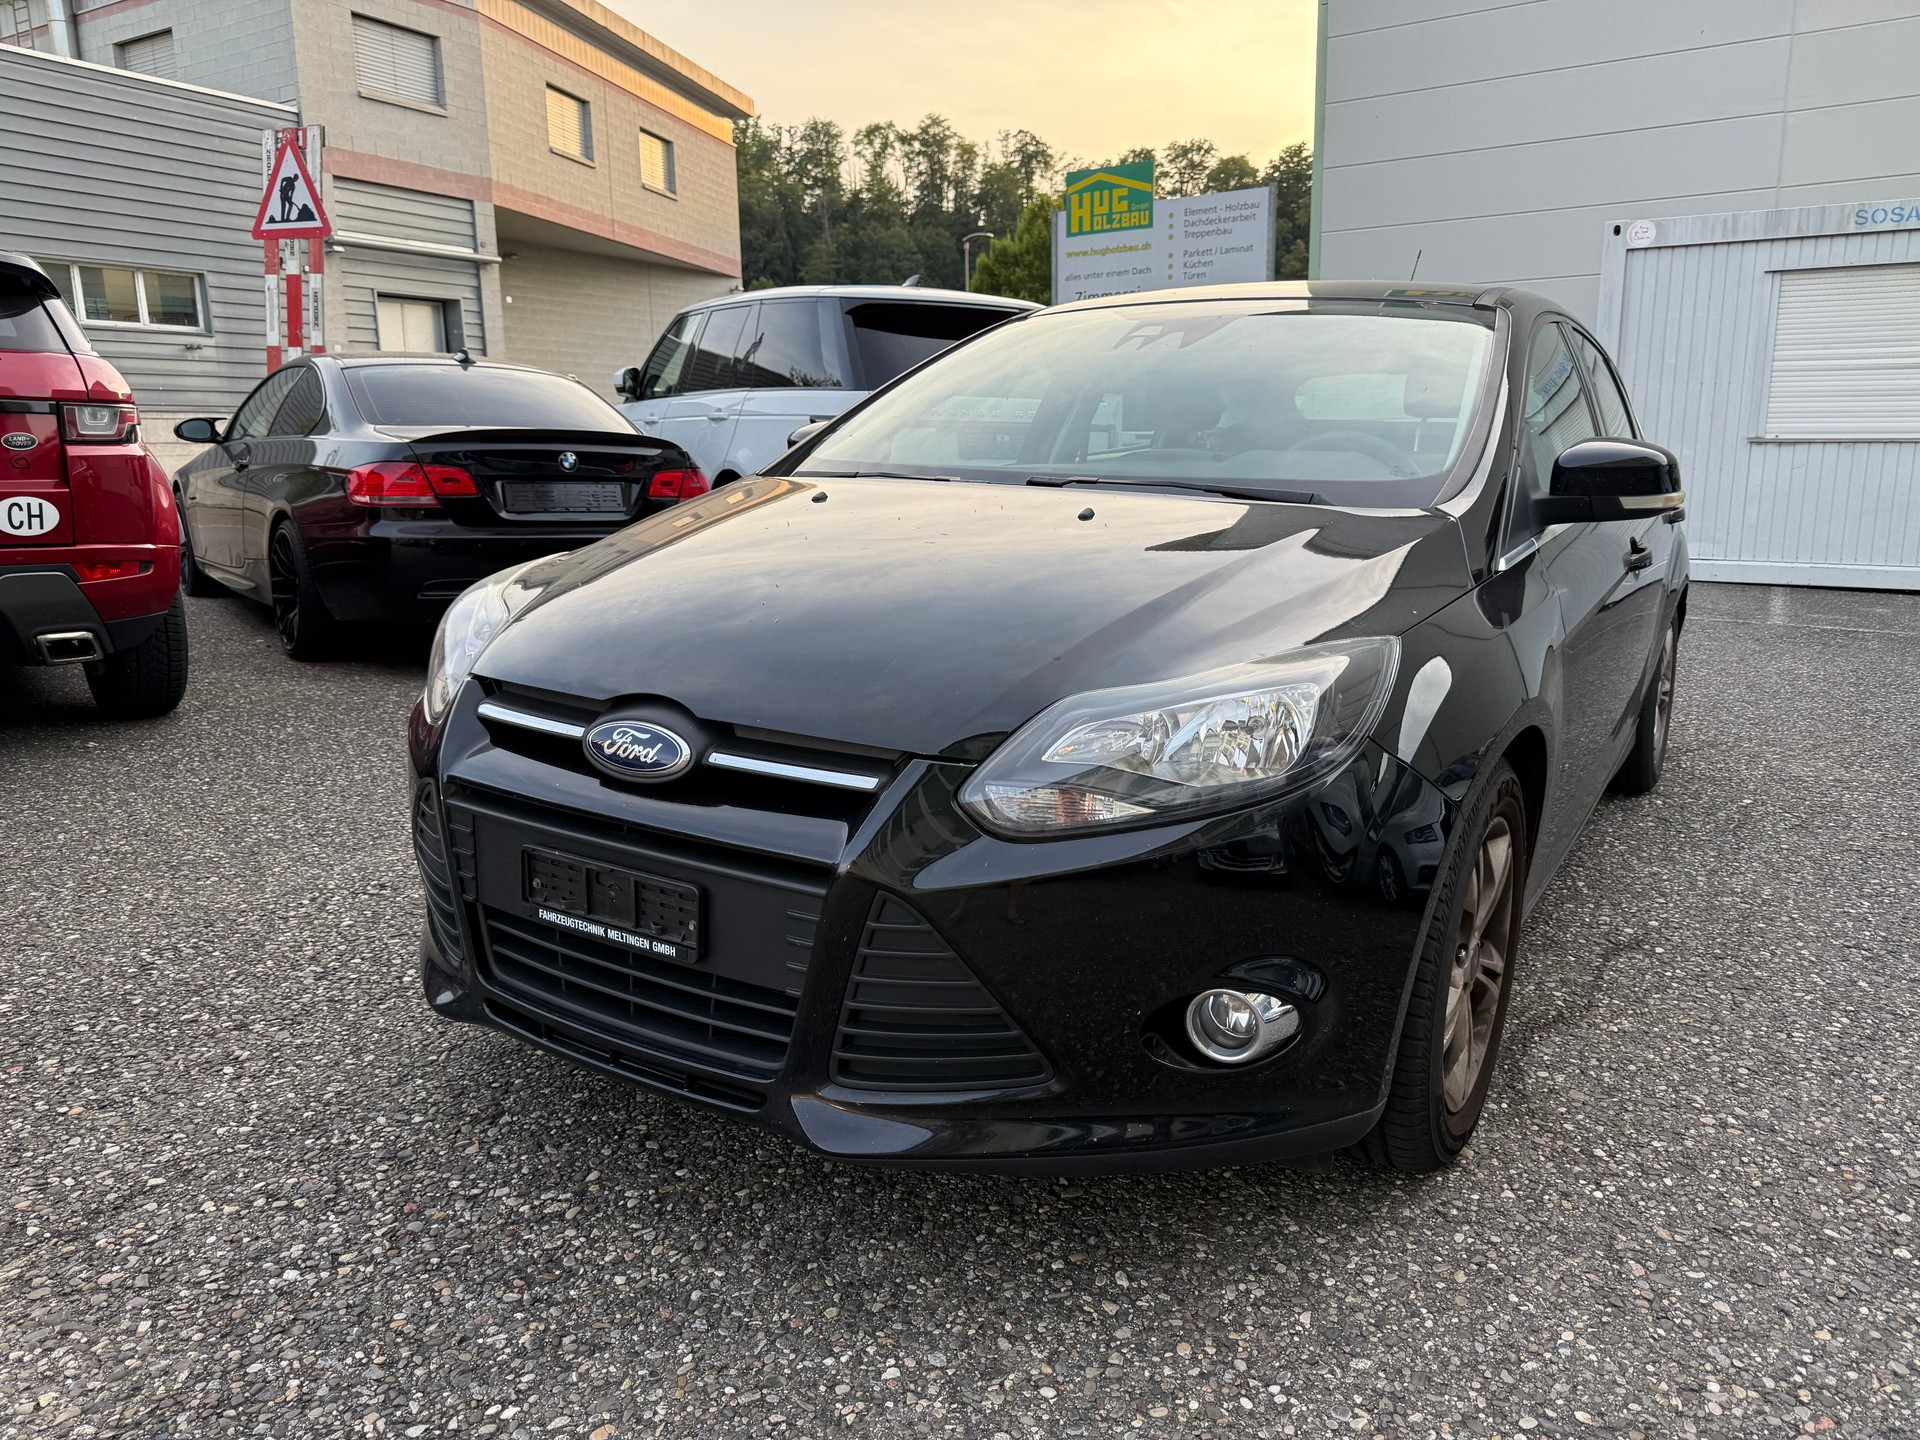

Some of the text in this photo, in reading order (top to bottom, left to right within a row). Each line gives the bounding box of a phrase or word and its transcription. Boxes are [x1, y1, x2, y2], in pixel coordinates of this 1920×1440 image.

[1071, 187, 1128, 233] HUG
[1184, 206, 1218, 217] Element
[1225, 201, 1260, 212] Holzbau
[1855, 205, 1920, 226] SOSA
[1184, 212, 1256, 228] Dachdeckerarbeit
[1184, 227, 1233, 239] Treppenbau
[1066, 242, 1152, 258] www.hugholzbau.ch
[1183, 248, 1213, 258] Parkett
[1219, 244, 1254, 255] Laminat
[1183, 259, 1214, 270] Küchen
[1065, 266, 1152, 281] alles unter einem Dach
[1183, 271, 1207, 280] Türen
[8, 502, 44, 530] CH
[603, 727, 663, 764] Ford
[538, 908, 676, 957] FAHRZEUGTECHNIK MELTINGEN GMBH
